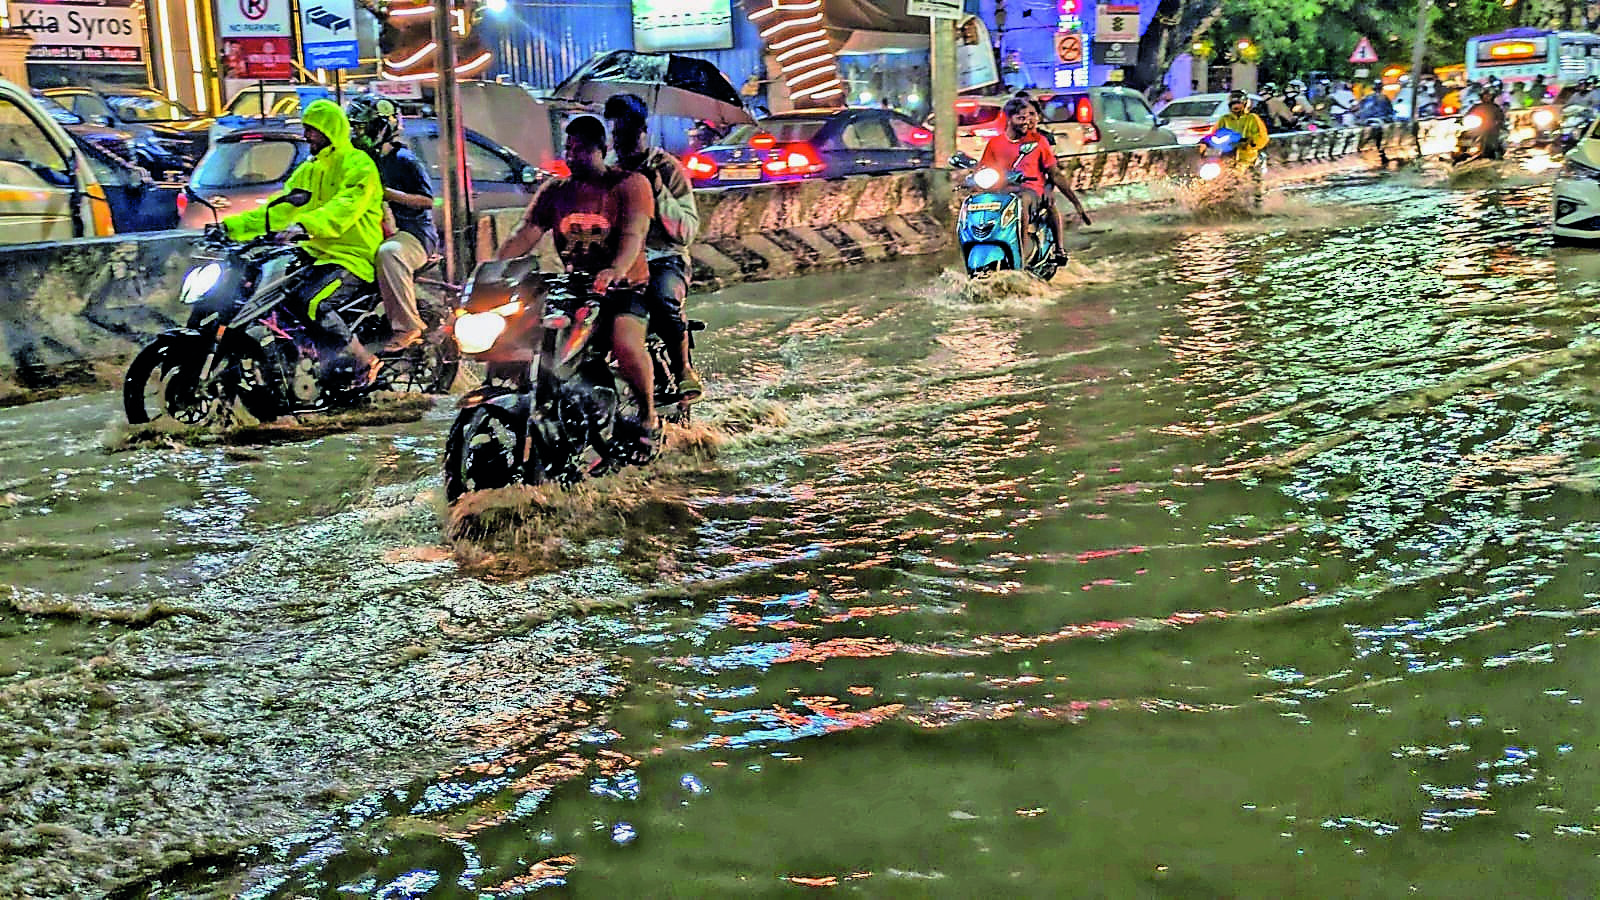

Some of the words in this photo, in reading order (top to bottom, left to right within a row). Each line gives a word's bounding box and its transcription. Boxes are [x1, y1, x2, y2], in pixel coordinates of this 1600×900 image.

[19, 9, 59, 33] Kia
[67, 10, 132, 40] Syros
[84, 47, 103, 58] the
